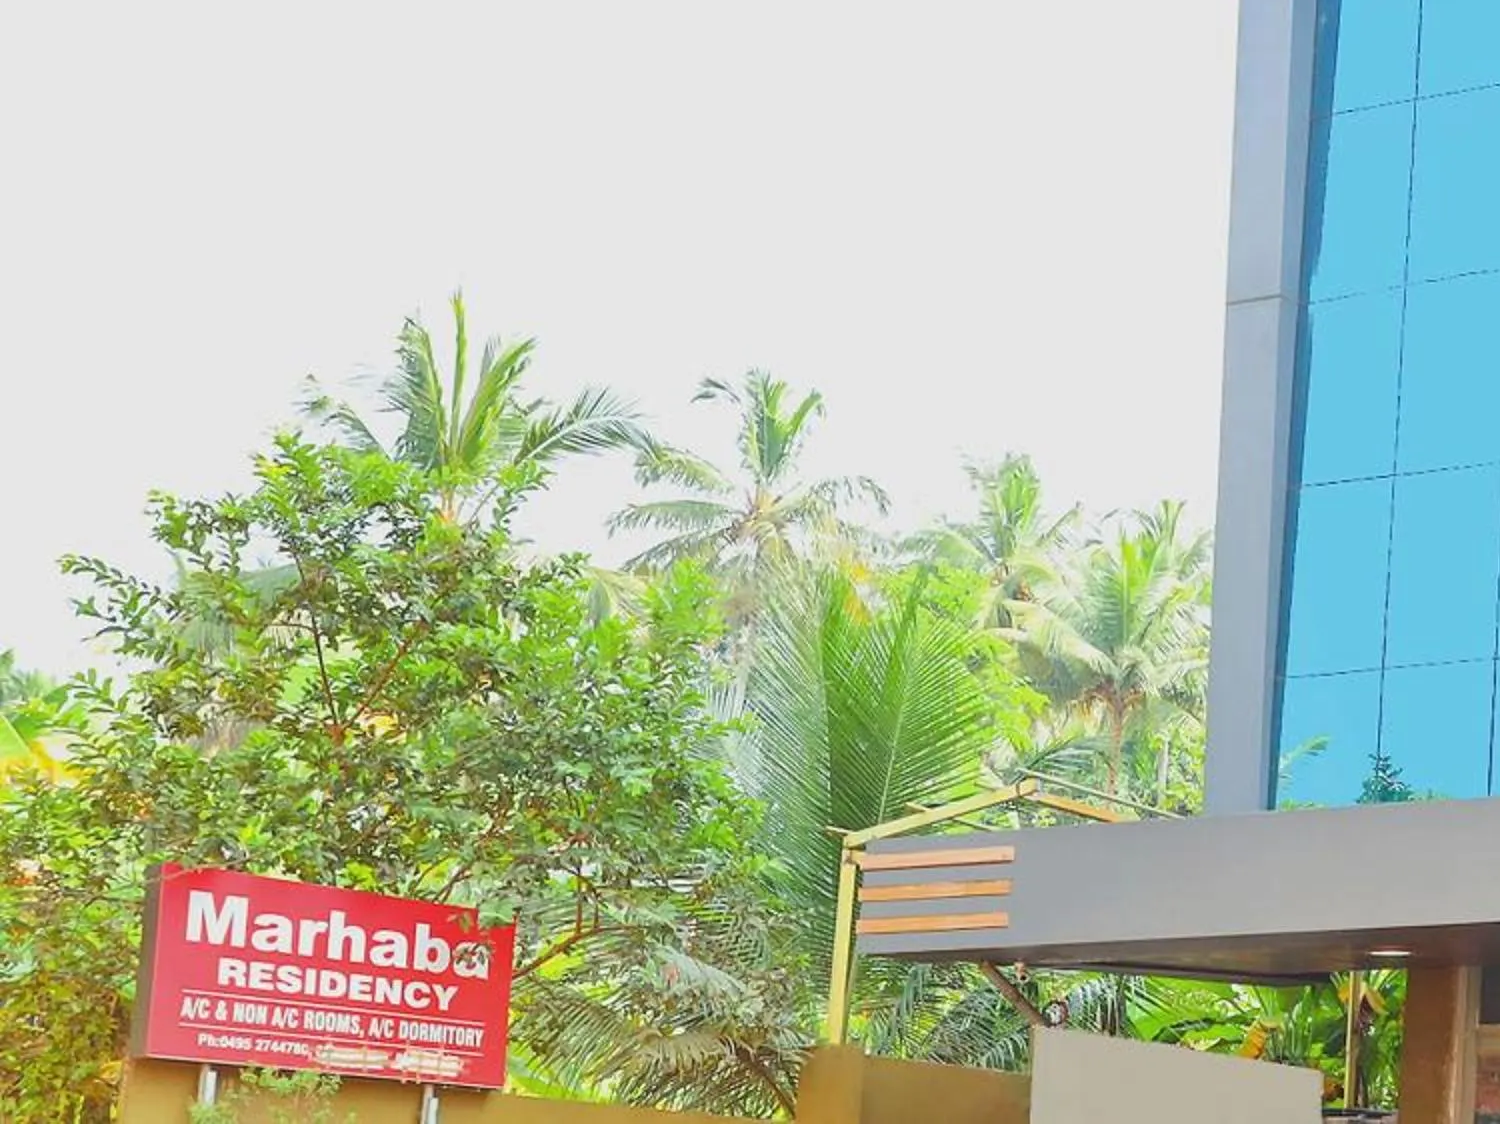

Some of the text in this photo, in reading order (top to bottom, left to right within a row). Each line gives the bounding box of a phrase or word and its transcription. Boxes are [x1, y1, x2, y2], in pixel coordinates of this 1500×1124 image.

[185, 890, 490, 980] Marhaba
[217, 957, 459, 1011] RESIDENCY
[180, 996, 485, 1048] A/C & NON A/C ROOMS, A/C DORMITORY
